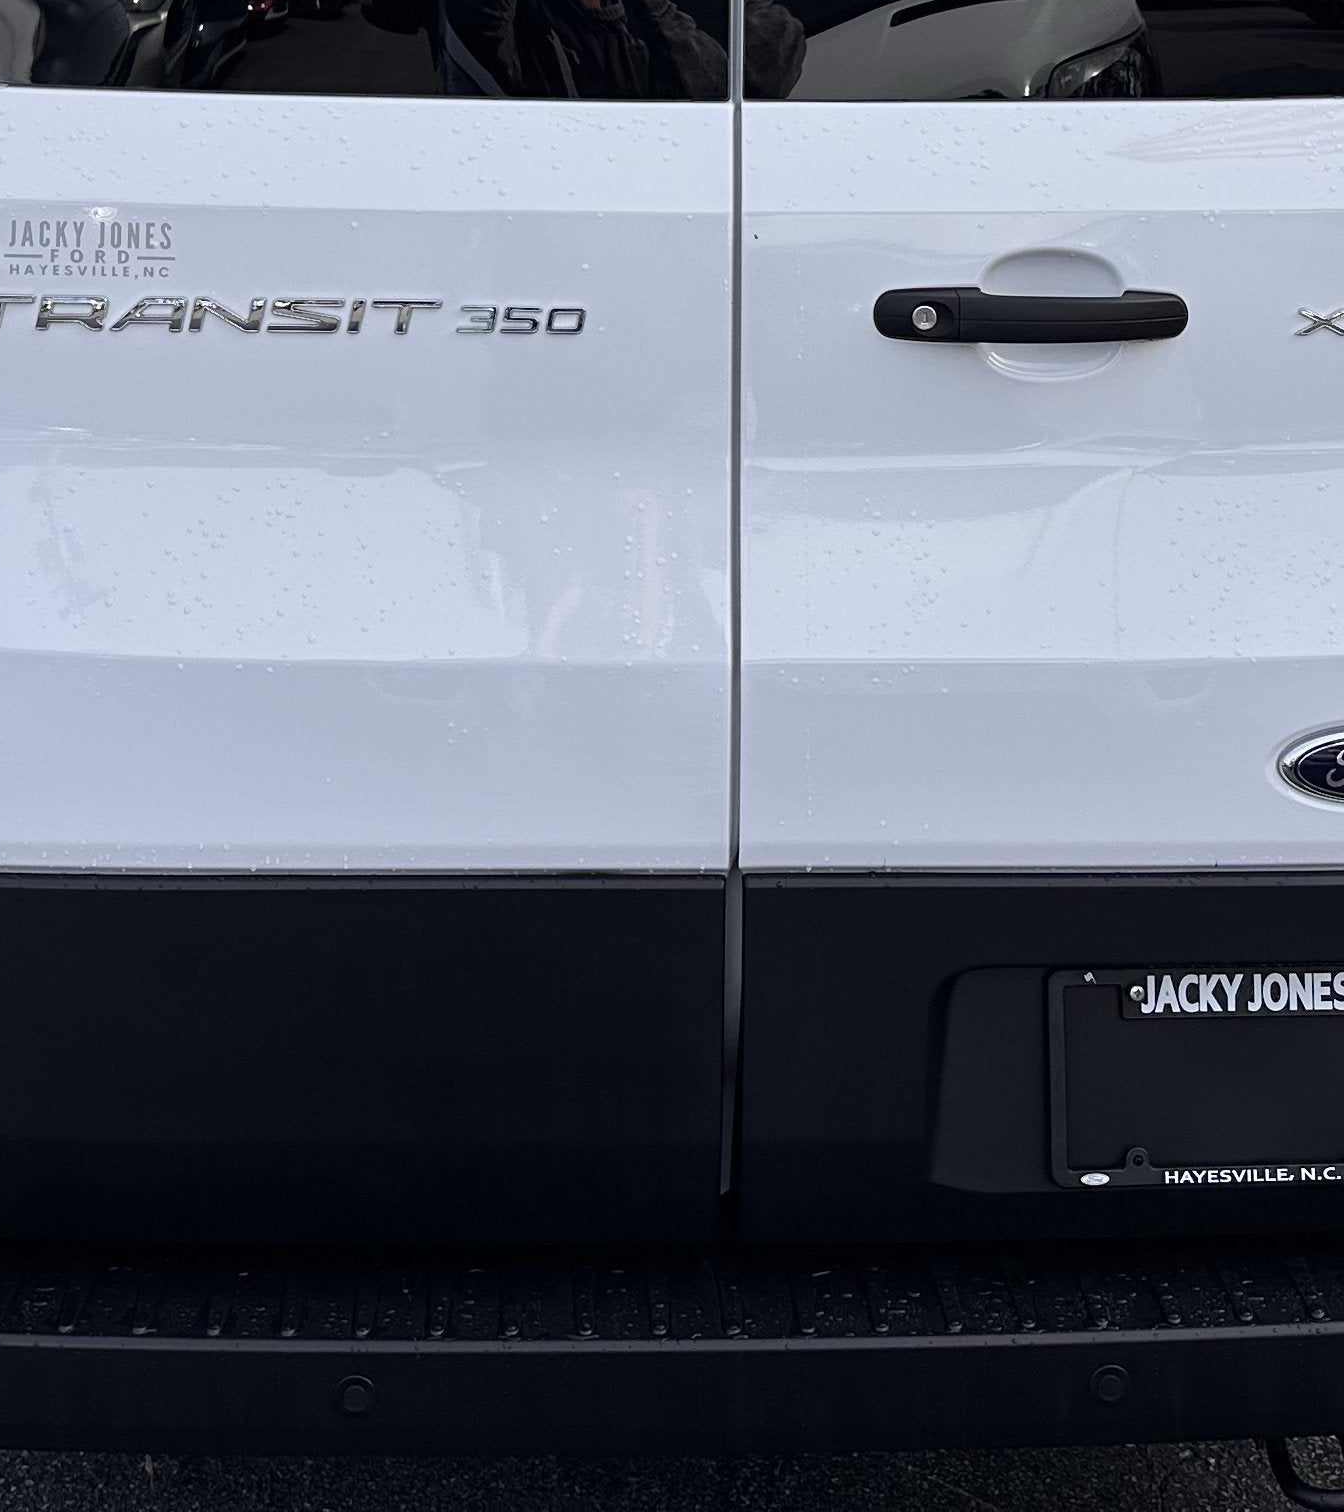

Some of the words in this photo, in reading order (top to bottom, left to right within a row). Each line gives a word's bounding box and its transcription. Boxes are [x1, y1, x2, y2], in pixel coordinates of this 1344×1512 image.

[9, 220, 84, 248] JACKY
[98, 221, 172, 250] JONES
[50, 249, 130, 264] FORD
[456, 305, 586, 335] 350
[1140, 974, 1243, 1014] JACKY
[1164, 1168, 1295, 1184] HAYESVILLE,
[1300, 1166, 1342, 1181] N.C.
